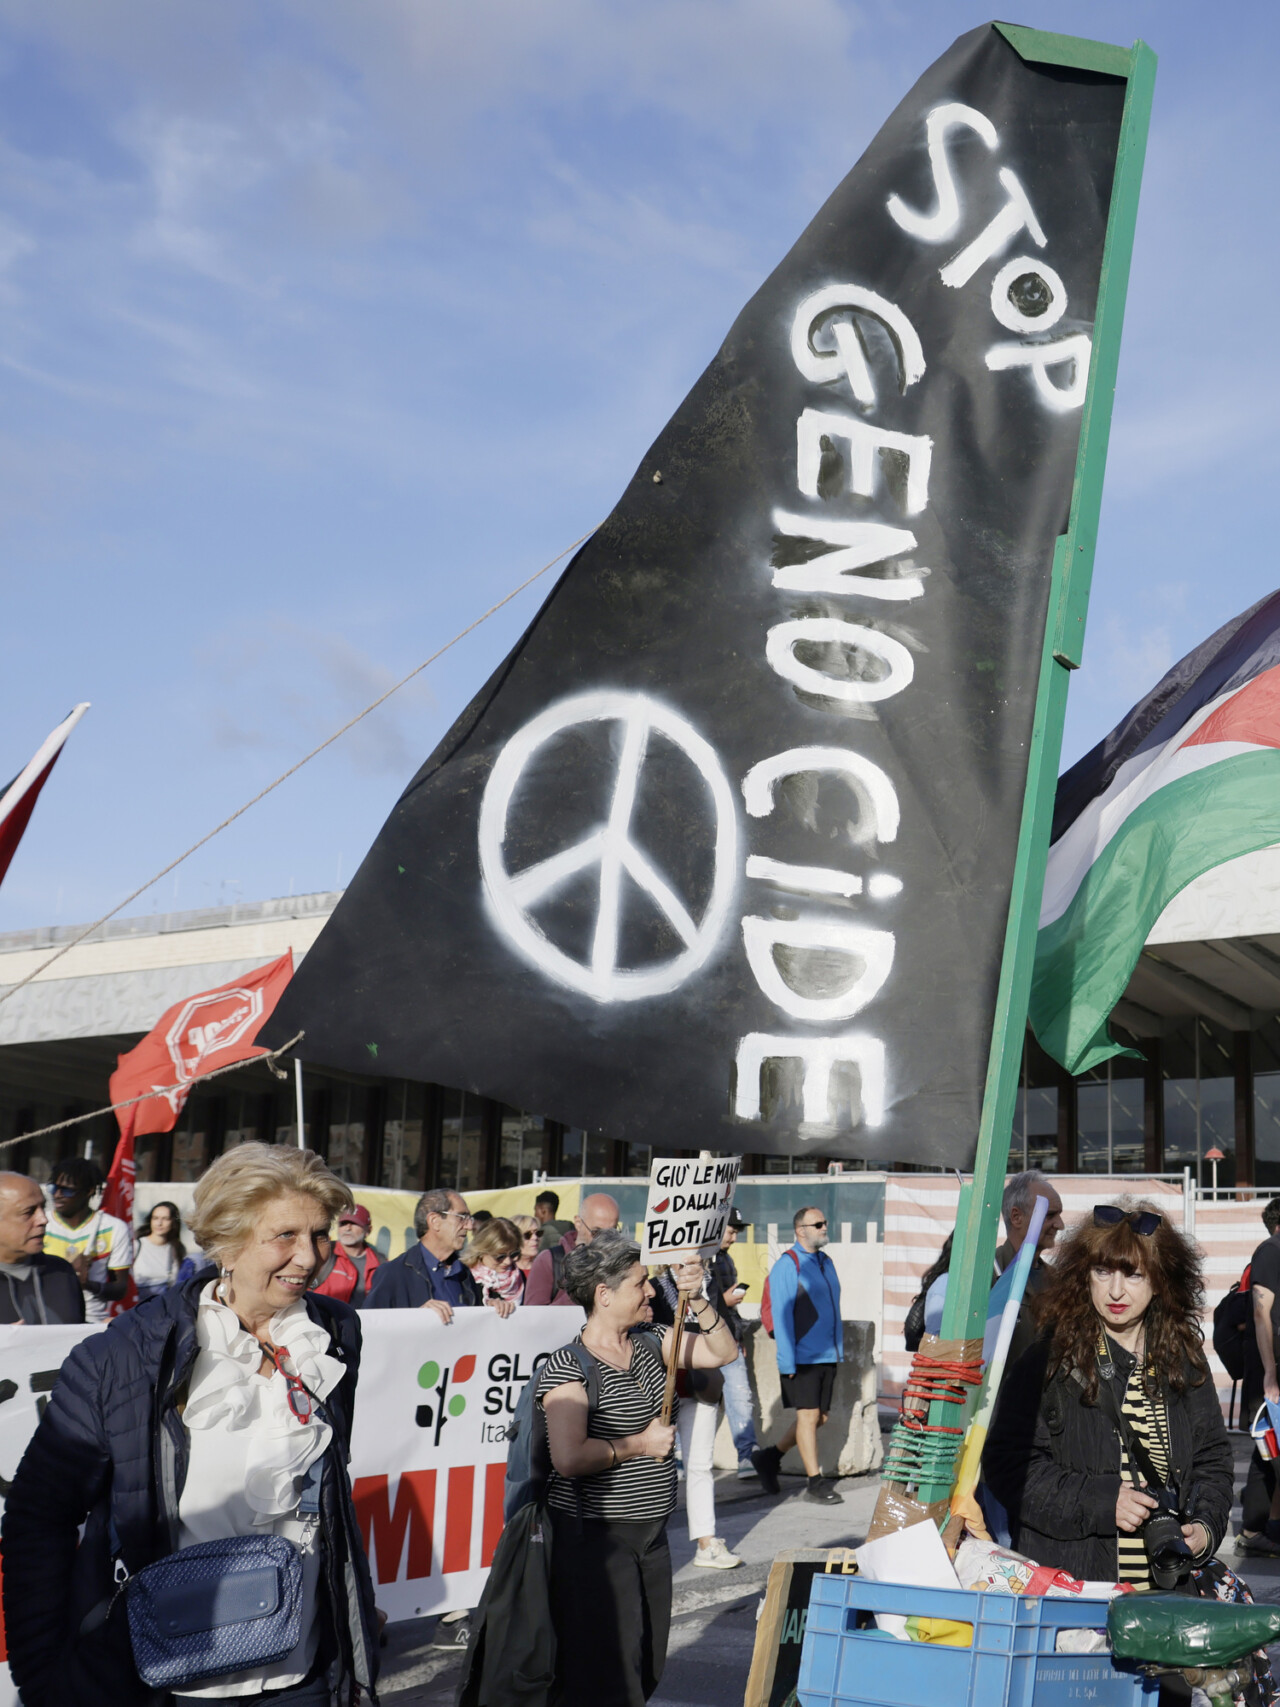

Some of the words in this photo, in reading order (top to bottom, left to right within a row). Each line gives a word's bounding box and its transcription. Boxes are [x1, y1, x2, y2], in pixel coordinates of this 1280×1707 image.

[886, 102, 1092, 412] STOP
[693, 1165, 714, 1185] LE
[672, 1192, 718, 1213] DALLA
[647, 1216, 725, 1249] FLOTILLA
[481, 1419, 512, 1444] Ita
